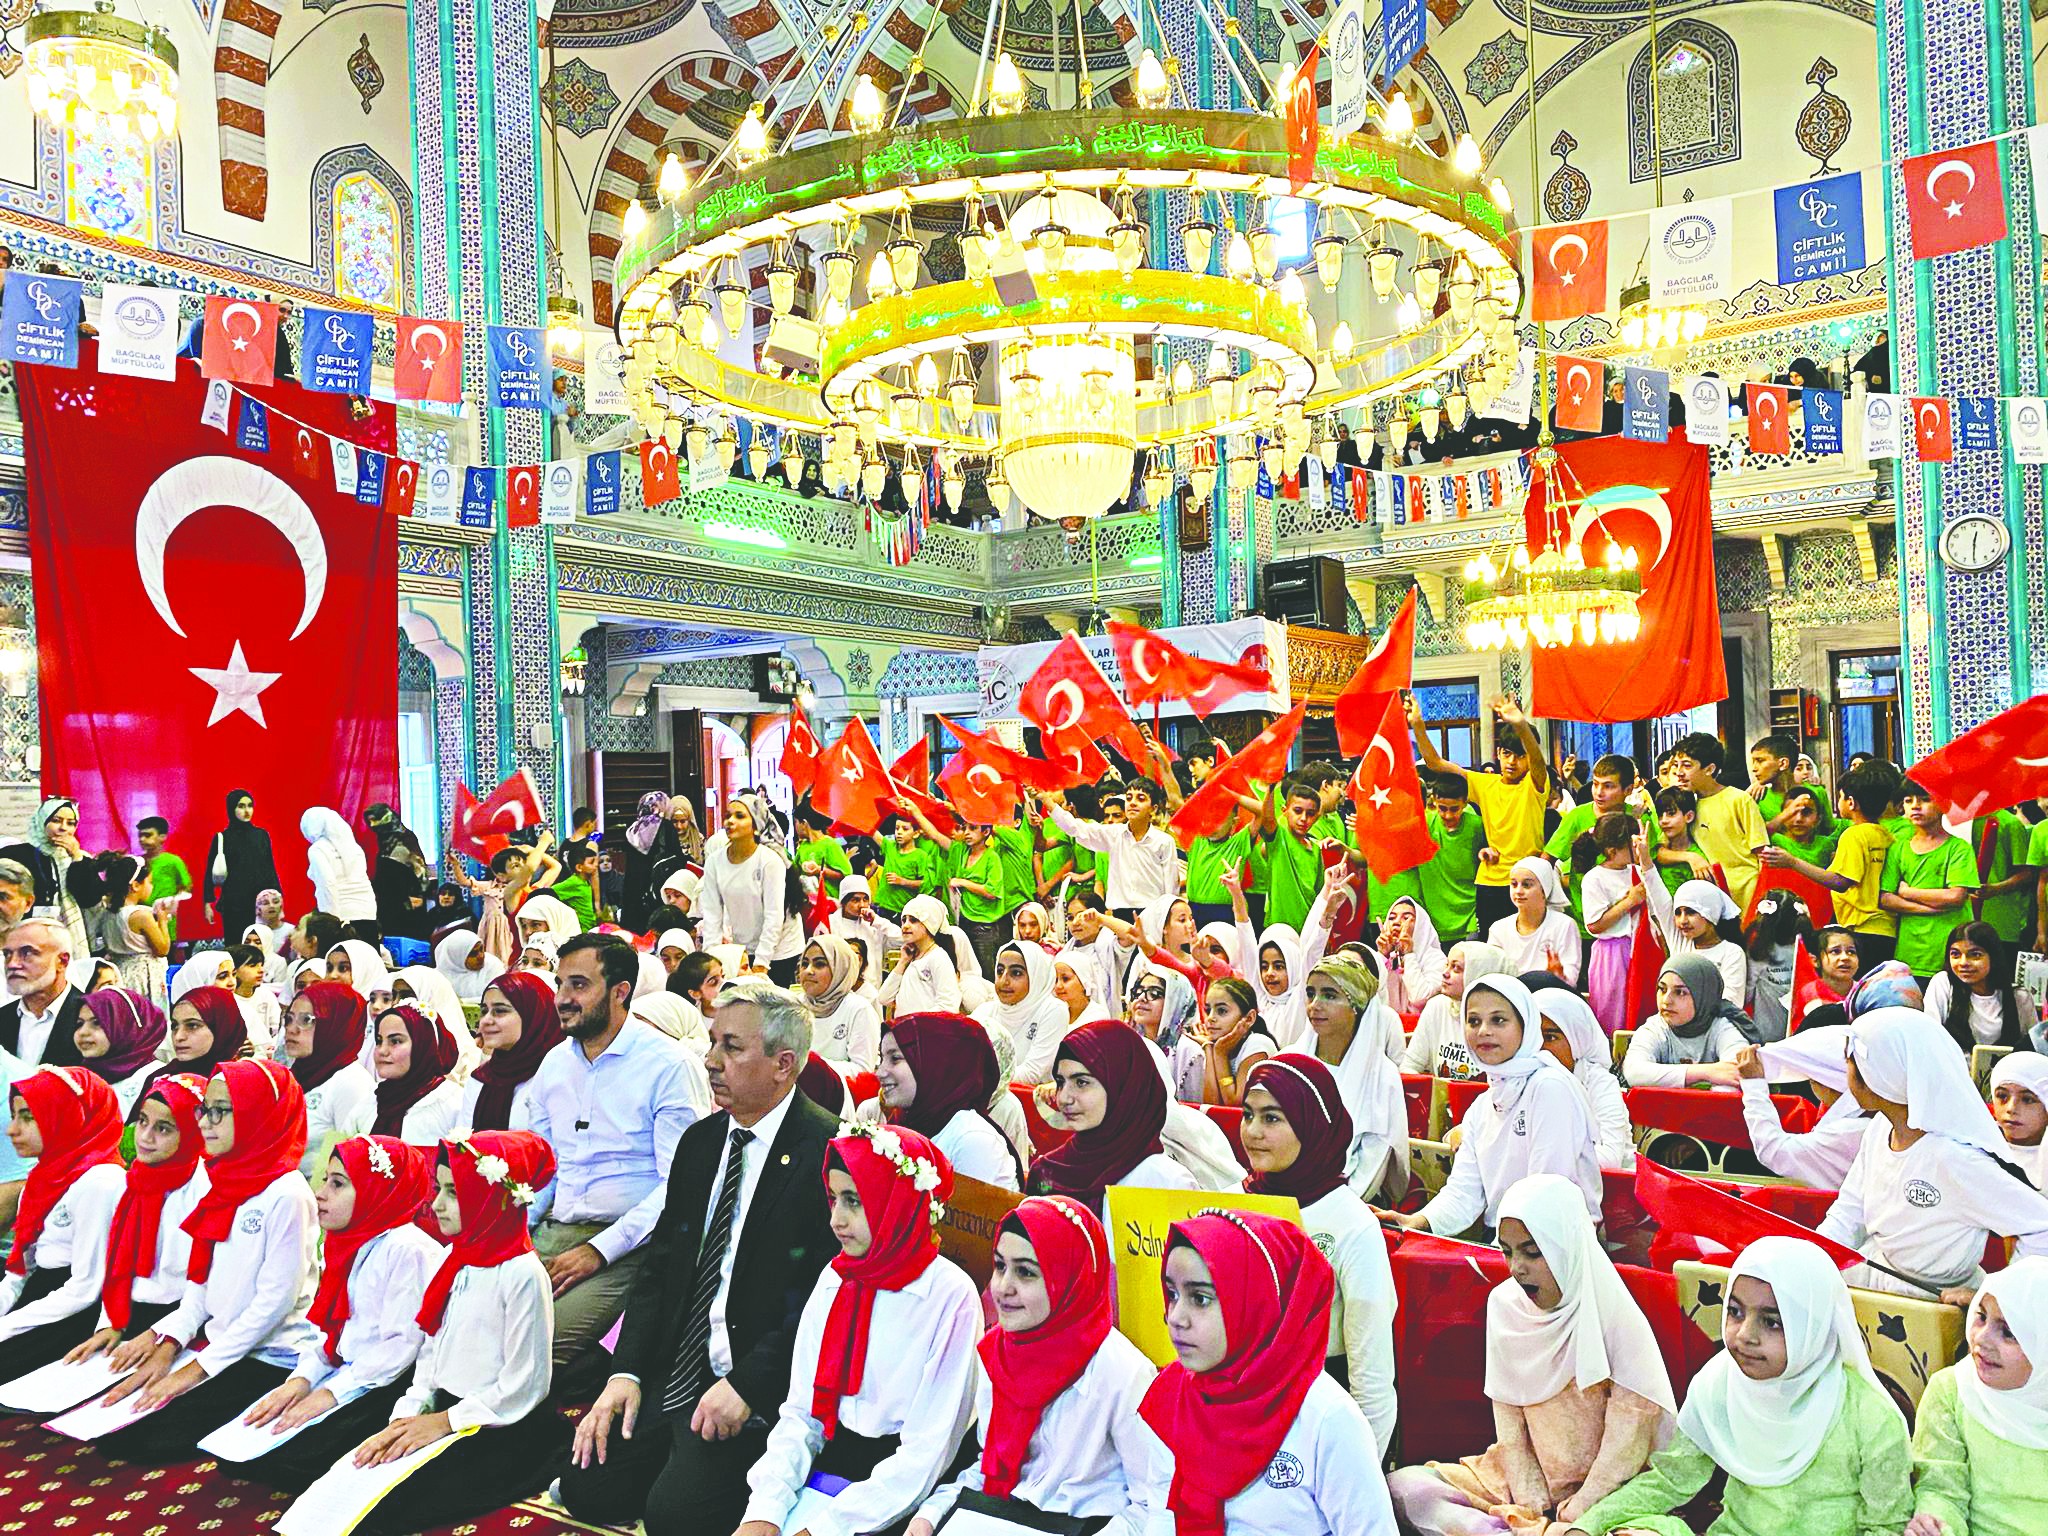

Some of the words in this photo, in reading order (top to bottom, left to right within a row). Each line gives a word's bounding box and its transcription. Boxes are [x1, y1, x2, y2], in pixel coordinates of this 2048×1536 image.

[1793, 232, 1846, 254] ÇİFTLİK
[1793, 246, 1846, 263] DEMİRCAN
[1794, 256, 1847, 277] CAMİİ
[1667, 273, 1714, 287] BAĞCILAR
[1662, 281, 1719, 297] MÜFTÜLÜĞÜ
[17, 322, 65, 339] ÇİFTLİK
[16, 335, 64, 348] DEMİRCAN
[16, 345, 64, 361] CAMİİ
[115, 349, 161, 361] BAĞCILAR
[111, 357, 165, 370] MÜFTÜLÜĞÜ
[316, 354, 360, 368] ÇİFTLİK
[316, 366, 359, 377] DEMİRCAN
[500, 369, 540, 382] ÇİFTLİK
[315, 376, 358, 389] CAMİİ
[500, 381, 540, 390] DEMİRCAN
[501, 391, 540, 401] CAMİİ
[1631, 410, 1660, 421] ÇİFTLİK
[1632, 429, 1660, 439] CAMİİ
[1811, 424, 1836, 434] ÇİFTLİK
[1812, 442, 1839, 451] CAMİİ
[593, 503, 614, 511] CAMİİ
